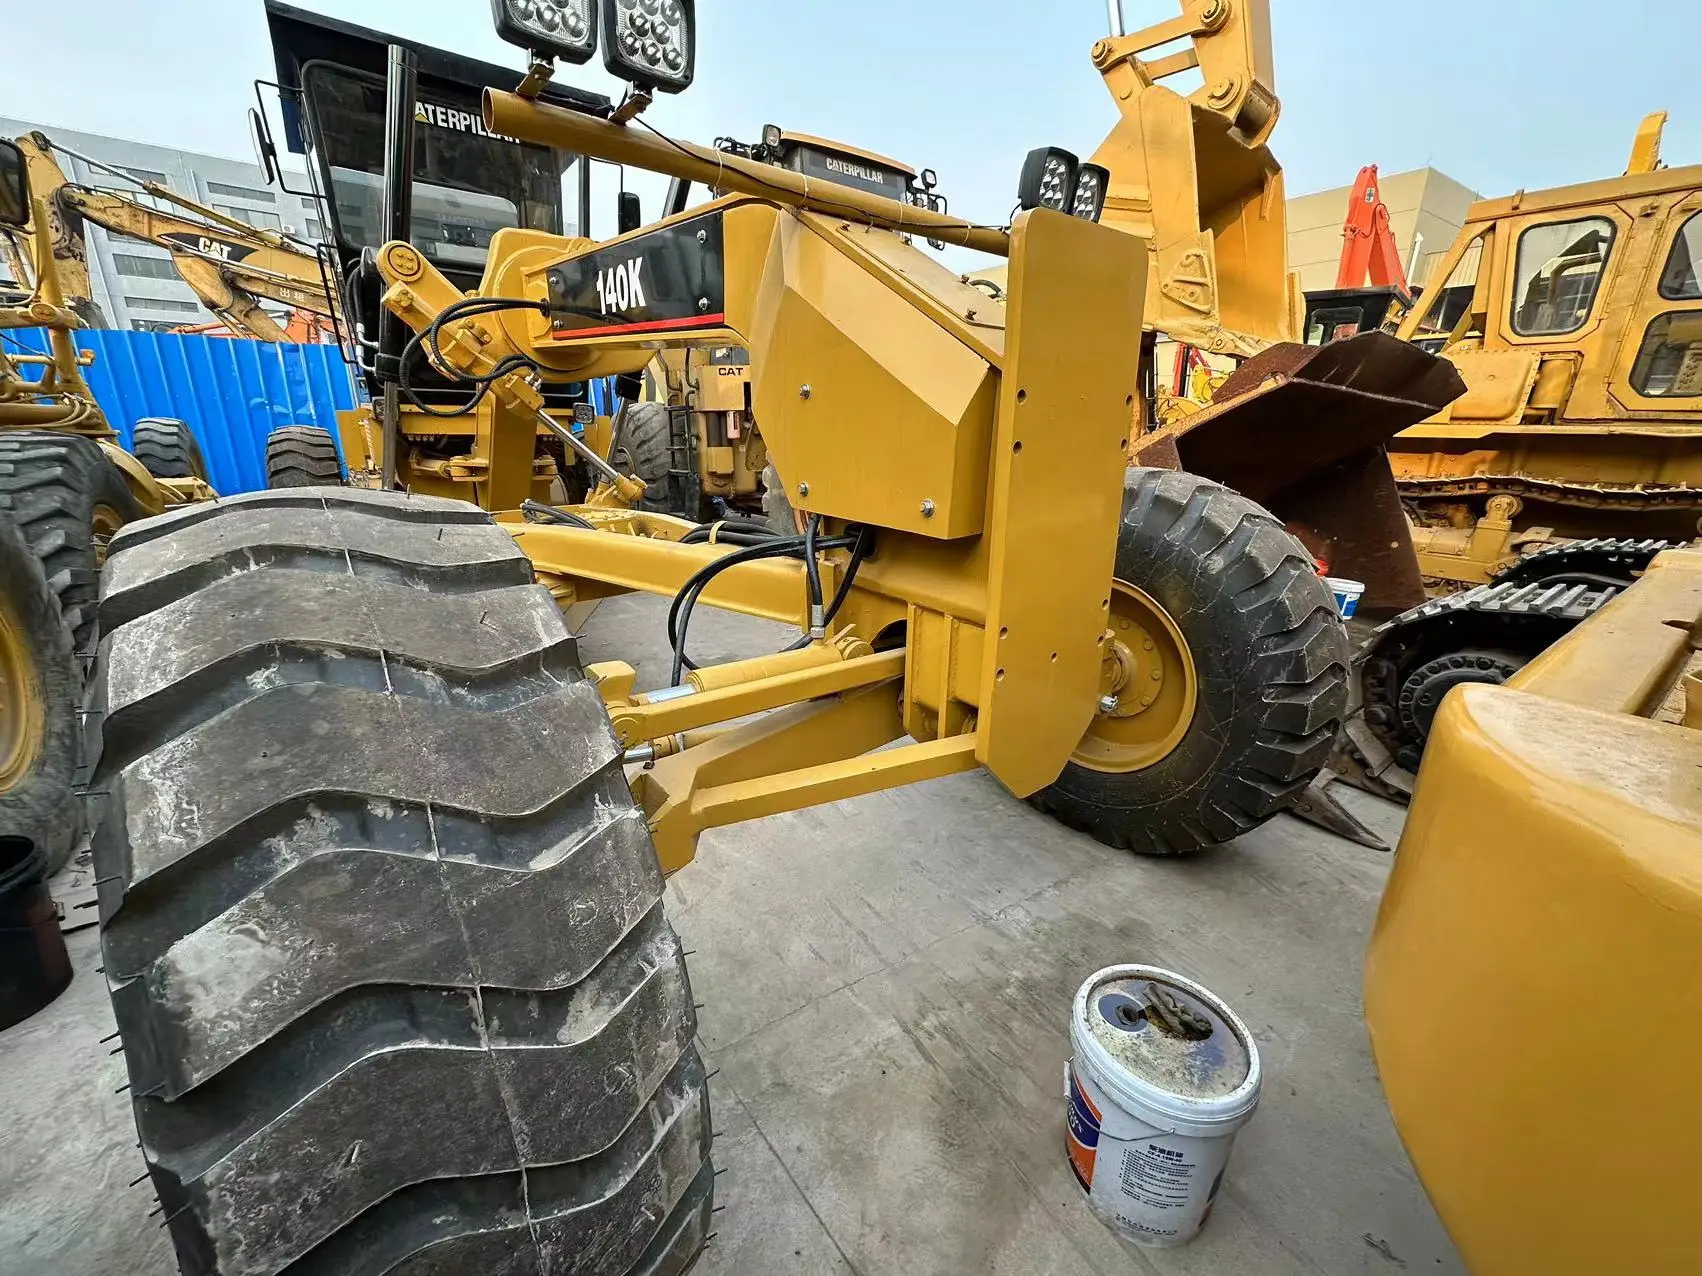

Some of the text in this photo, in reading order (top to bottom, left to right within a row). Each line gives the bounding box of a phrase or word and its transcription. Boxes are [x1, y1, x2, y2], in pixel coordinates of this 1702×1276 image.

[414, 101, 520, 144] ATERPIL
[826, 157, 884, 184] CATERPILLAR
[198, 237, 232, 260] CAT
[596, 256, 647, 315] 140K
[718, 367, 744, 376] CAT
